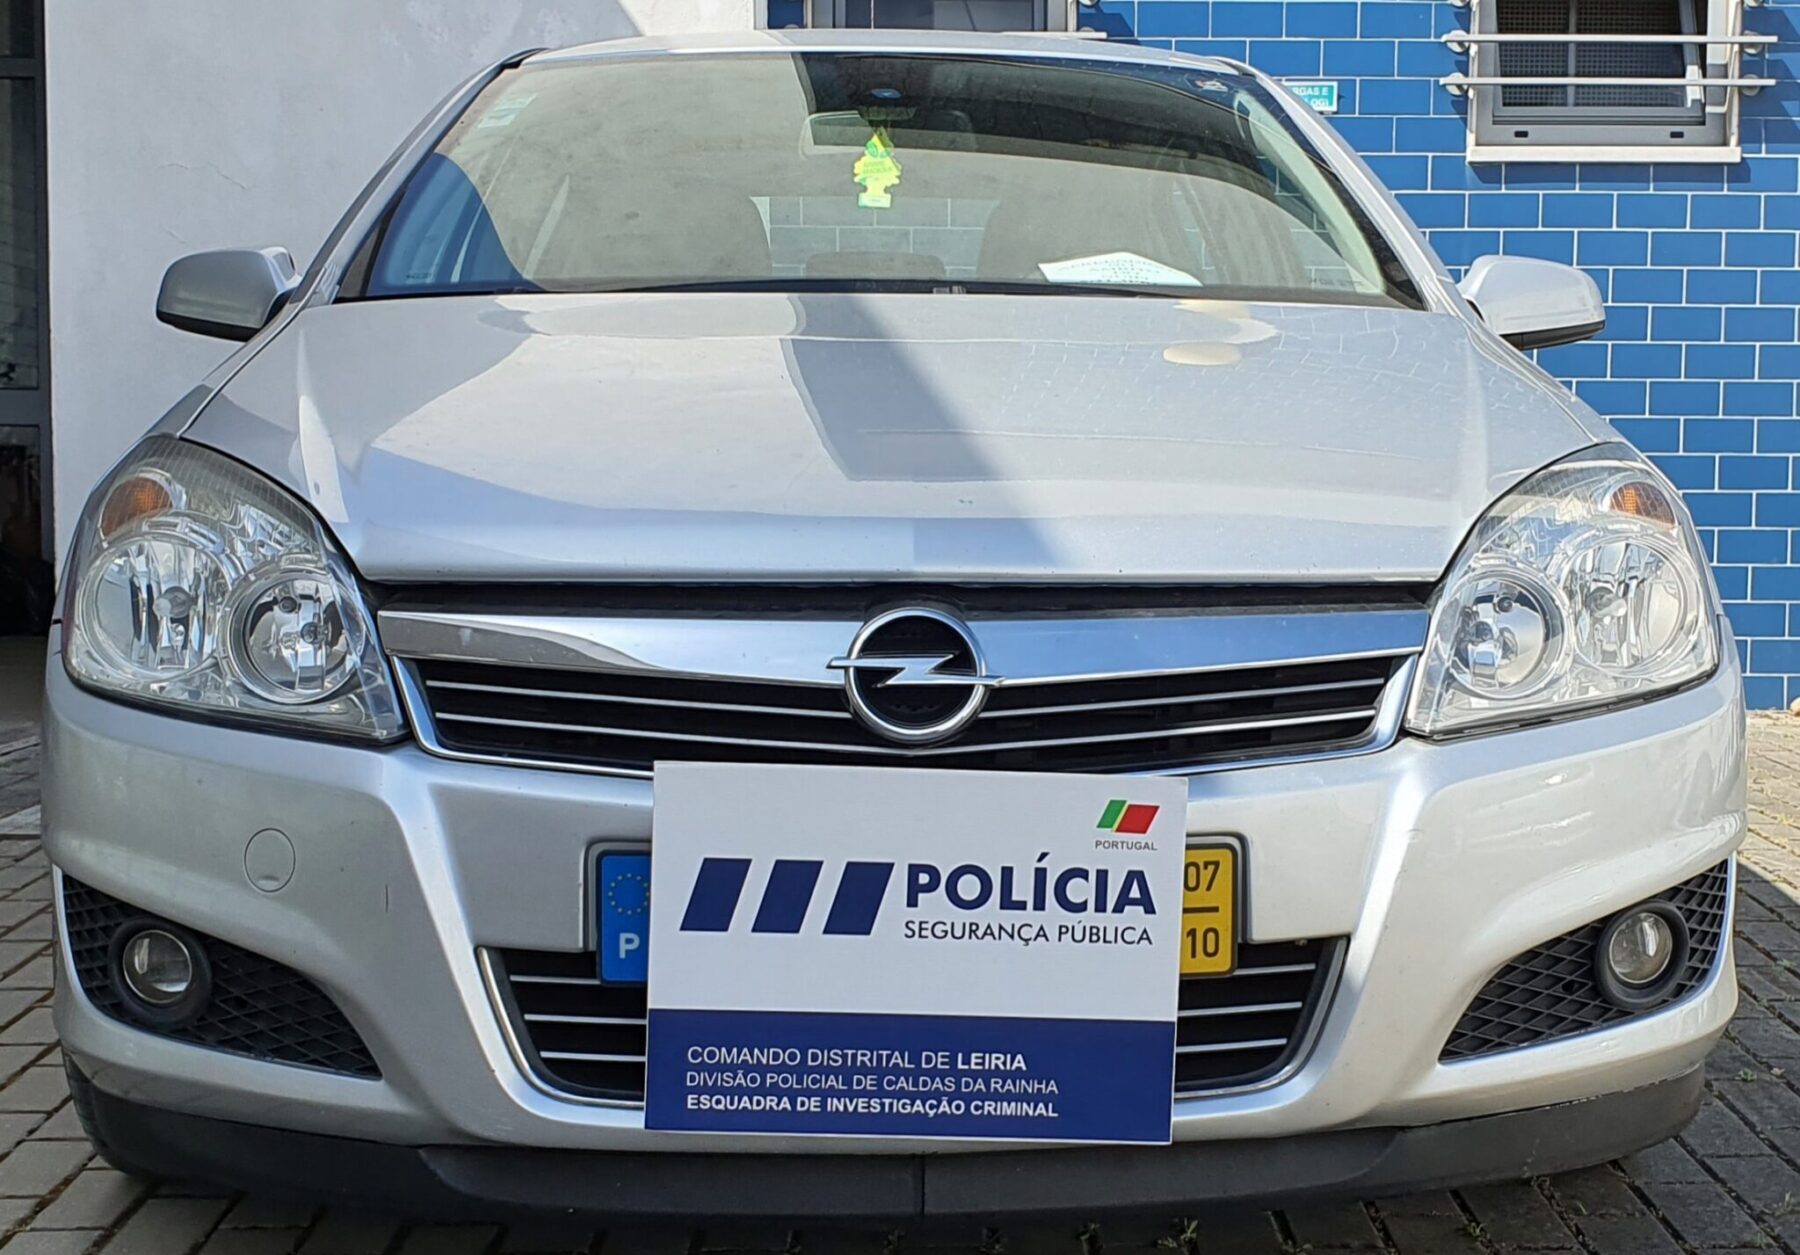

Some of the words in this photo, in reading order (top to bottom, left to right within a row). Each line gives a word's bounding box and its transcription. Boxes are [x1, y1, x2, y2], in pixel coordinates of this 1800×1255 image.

[1094, 839, 1158, 851] PORTUGAL
[906, 851, 1157, 916] POLÍCIA
[1184, 860, 1220, 892] 07
[618, 932, 641, 960] P
[904, 919, 1050, 947] SEGURANÇA
[1057, 919, 1153, 946] PÚBLICA
[1186, 926, 1220, 959] 10
[686, 1046, 801, 1066] COMANDO
[807, 1048, 915, 1069] DISTRITAL
[921, 1051, 950, 1069] DE
[957, 1052, 1027, 1071] LEIRIA
[686, 1069, 761, 1088] DIVISÃO
[766, 1073, 848, 1090] POLICIAL
[852, 1074, 878, 1090] DE
[883, 1075, 956, 1092] CALDAS
[961, 1077, 987, 1093] DA
[990, 1078, 1059, 1095] RAINHA
[687, 1094, 792, 1112] ESQUADRA
[796, 1096, 822, 1112] DE
[826, 1096, 966, 1118] INVESTIGAÇÃO
[970, 1100, 1060, 1117] CRIMINAL
